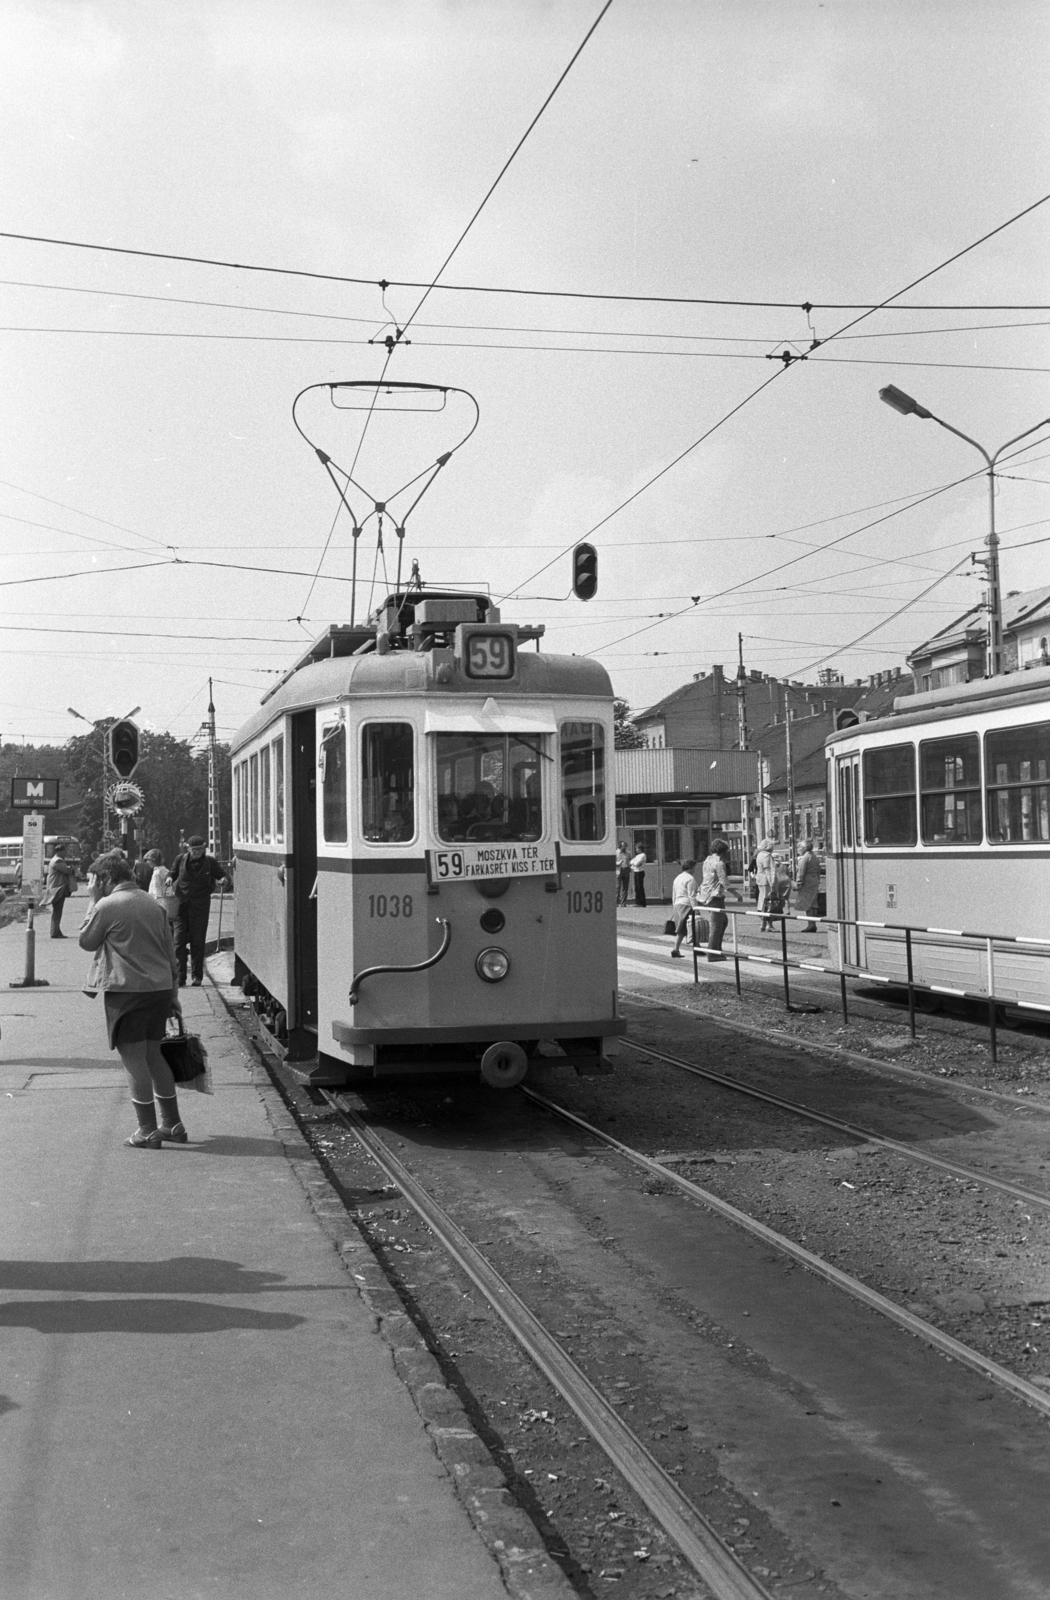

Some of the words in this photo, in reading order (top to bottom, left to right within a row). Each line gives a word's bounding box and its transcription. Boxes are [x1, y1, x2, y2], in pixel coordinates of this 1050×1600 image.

[471, 637, 505, 670] 59
[27, 782, 43, 796] M
[437, 853, 463, 877] 59
[477, 848, 518, 861] MOSZKVA
[521, 845, 538, 858] TÉR
[465, 860, 509, 876] FARKASRÉT
[512, 861, 528, 874] KISS
[531, 860, 538, 872] F.
[540, 857, 555, 871] TÉR
[368, 894, 413, 918] 1038
[566, 890, 603, 914] 1038
